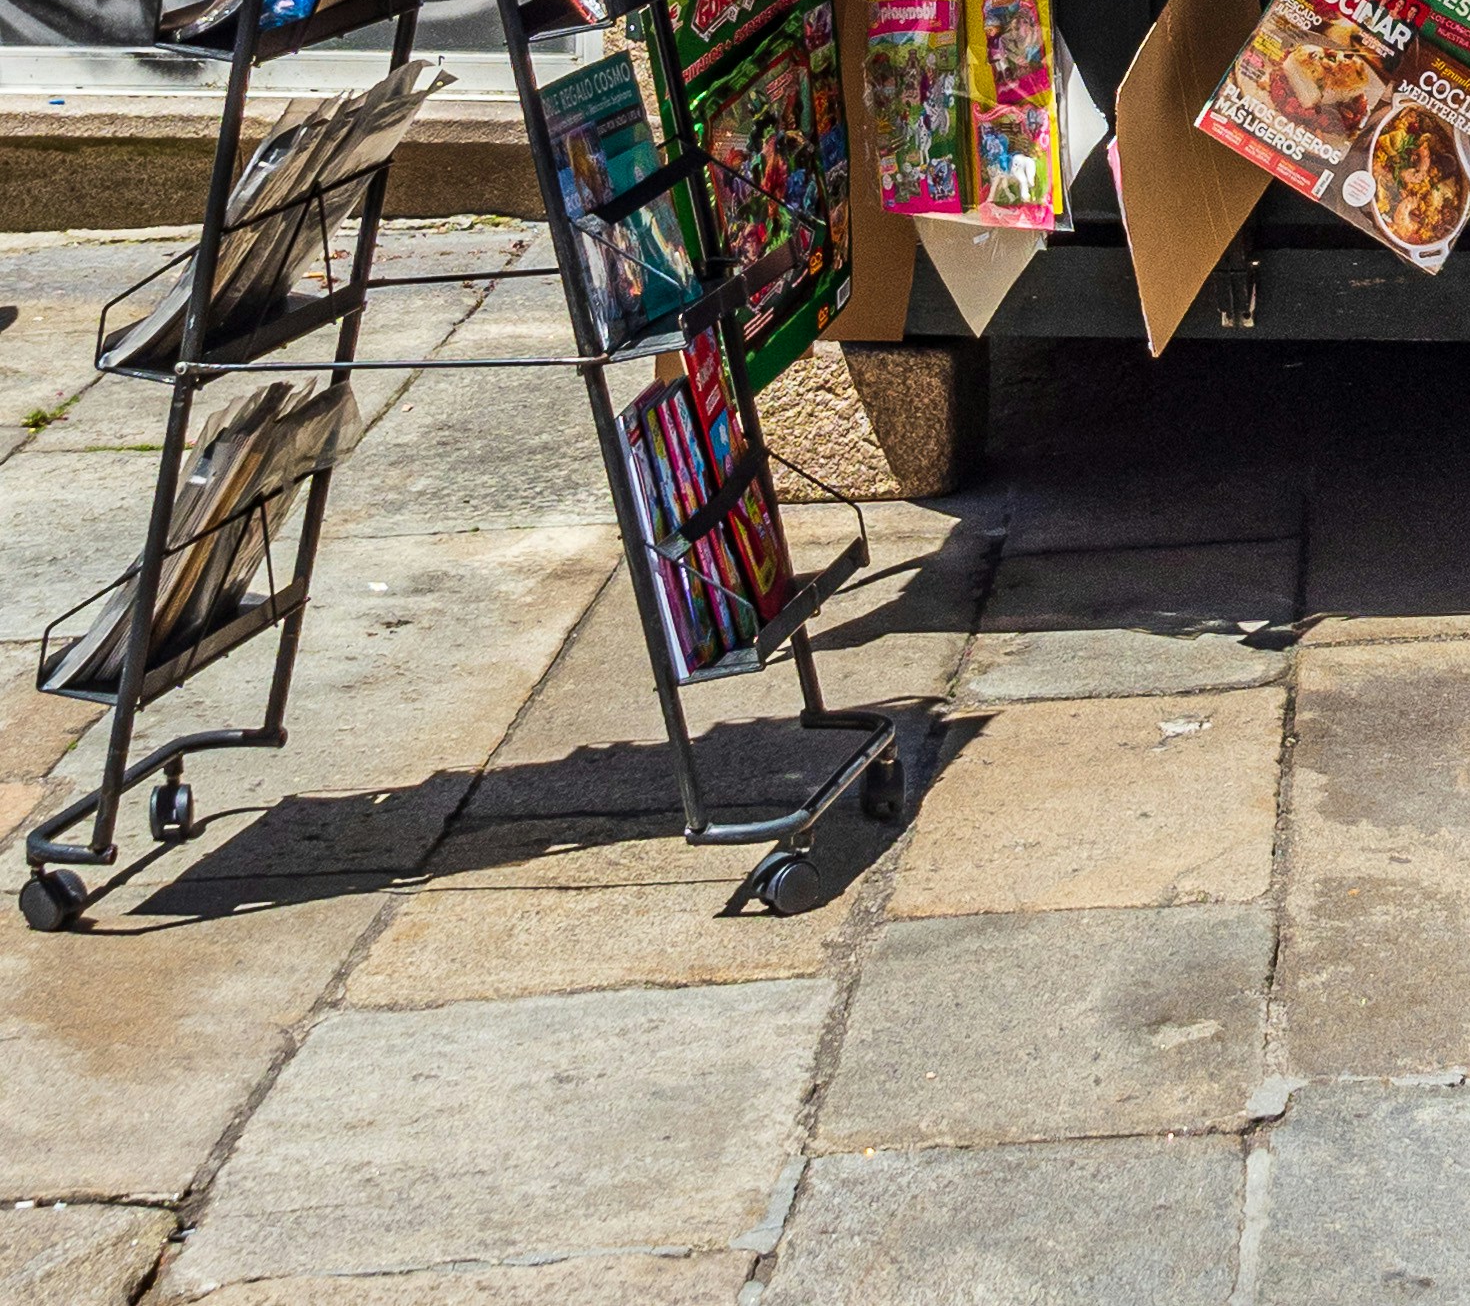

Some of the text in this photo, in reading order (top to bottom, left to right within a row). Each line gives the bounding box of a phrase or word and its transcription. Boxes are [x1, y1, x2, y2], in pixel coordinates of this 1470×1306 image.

[1274, 3, 1313, 32] JUGOSO
[592, 62, 632, 94] COSMO
[1430, 57, 1446, 72] 30
[1214, 95, 1246, 127] MÁS
[1242, 114, 1304, 161] LIGEROS
[1223, 83, 1275, 123] PLATOS
[1271, 109, 1343, 165] CASEROS
